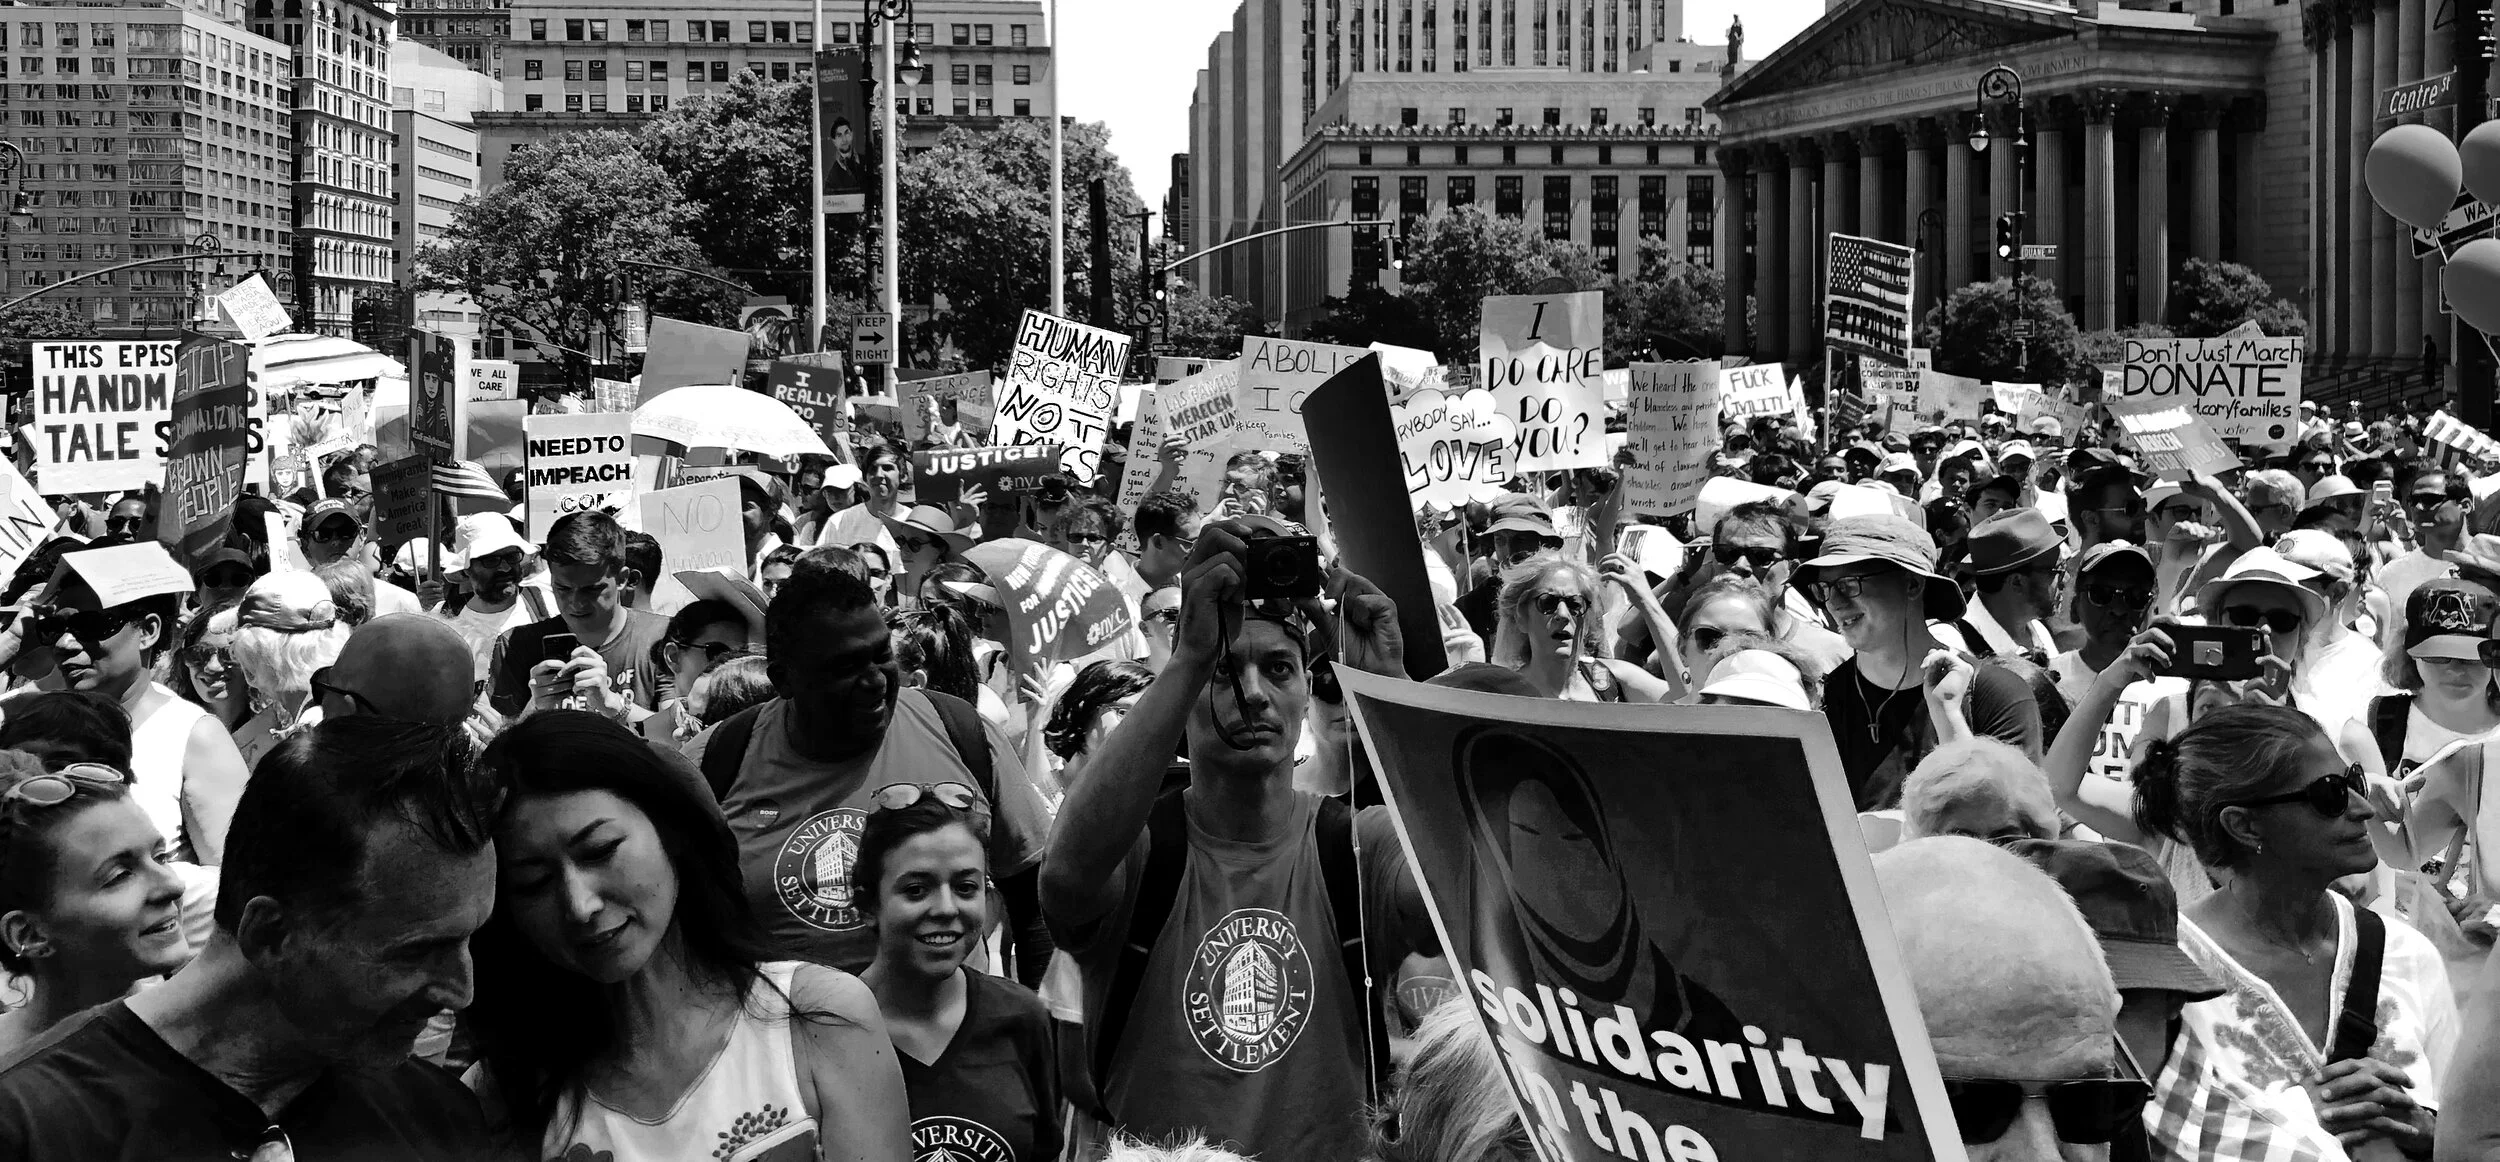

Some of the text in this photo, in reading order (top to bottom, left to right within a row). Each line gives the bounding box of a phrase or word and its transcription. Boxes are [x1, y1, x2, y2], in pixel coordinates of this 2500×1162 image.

[2389, 75, 2450, 115] Centre St
[2024, 248, 2046, 257] DUANE
[221, 283, 256, 302] WATER
[857, 317, 886, 327] KEEP
[1527, 302, 1548, 340] I
[44, 344, 182, 368] THIS EPIS
[855, 350, 889, 360] RIGHT
[1019, 312, 1130, 377] HUMAN
[2126, 339, 2302, 363] Don't Just March
[177, 342, 234, 396] STOP
[1251, 340, 1361, 375] ABOLI
[1488, 346, 1600, 392] DO CARE
[479, 381, 502, 391] CARE
[491, 369, 507, 379] ALL
[795, 371, 811, 388] I
[917, 376, 969, 393] ZERO
[1011, 351, 1117, 409] RIGHTS
[1631, 370, 1648, 391] We
[1652, 372, 1677, 392] heard
[1682, 373, 1697, 393] the
[1730, 369, 1773, 392] FUCK
[2123, 363, 2288, 397] DONATE
[42, 373, 167, 414] HANDM
[775, 384, 837, 407] REALLY
[1164, 390, 1188, 412] LAS
[1723, 394, 1783, 416] CIVILITY
[1000, 384, 1105, 443] NOT
[1170, 393, 1233, 430] MERECEN
[1520, 396, 1562, 423] DO
[1629, 397, 1639, 416] of
[169, 404, 245, 449] CRIMINALIZING
[1144, 414, 1158, 425] We
[1235, 421, 1266, 432] #Keep
[1398, 404, 1448, 442] RYBODY
[1672, 414, 1687, 431] We
[44, 422, 139, 463] TALE
[1137, 440, 1157, 448] who
[1140, 427, 1157, 437] the
[1184, 420, 1218, 444] STAR
[1265, 430, 1295, 440] Families
[1514, 412, 1589, 463] YOU?
[530, 436, 624, 457] NEED TO
[1136, 450, 1149, 459] for
[1628, 436, 1648, 452] we'll
[1653, 441, 1666, 458] get
[1670, 439, 1678, 452] to
[1682, 437, 1698, 450] hear
[167, 444, 224, 494] BROWN
[925, 446, 1048, 476] JUSTICE!
[1131, 468, 1151, 477] and
[1401, 438, 1505, 494] LOVE
[1655, 460, 1665, 472] of
[372, 461, 428, 486] Immigrants
[530, 463, 630, 487] IMPEACH
[177, 463, 240, 529] PEOPLE
[391, 487, 416, 501] Make
[1127, 479, 1199, 496] you to
[388, 501, 426, 520] America
[664, 494, 724, 536] NO
[1631, 498, 1656, 508] wrists
[1663, 499, 1676, 508] and
[396, 517, 423, 535] Great
[1004, 563, 1032, 590] NEW
[1020, 594, 1040, 613] FOR
[1029, 566, 1105, 654] JUSTICE!
[617, 669, 635, 685] OF
[787, 814, 865, 855] UNIVERS
[781, 876, 861, 925] SETTLE
[1201, 917, 1298, 966] UNIVERSITY
[1190, 986, 1306, 1064] SETTLEMENT
[1470, 968, 1892, 1142] solidarity
[1497, 1034, 1570, 1135] in
[1570, 1079, 1719, 1162] the
[912, 1125, 1009, 1162] VERSITY
